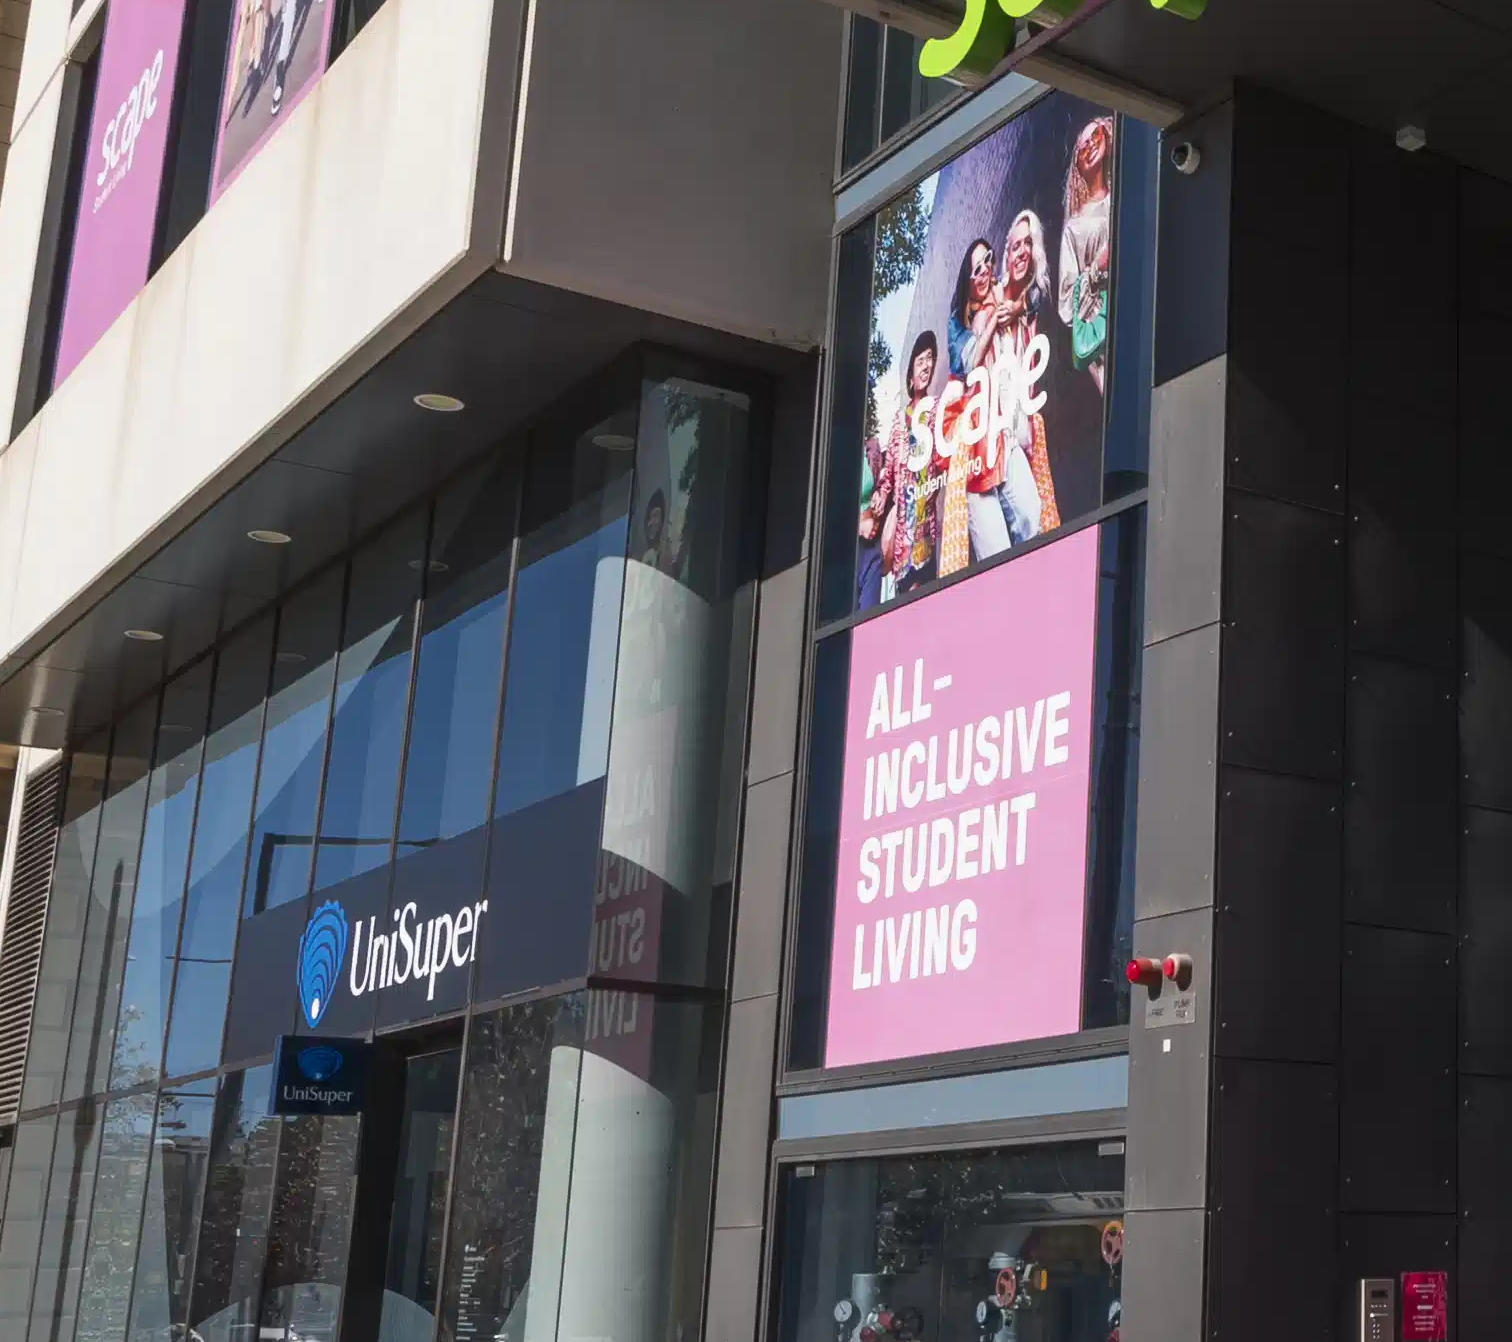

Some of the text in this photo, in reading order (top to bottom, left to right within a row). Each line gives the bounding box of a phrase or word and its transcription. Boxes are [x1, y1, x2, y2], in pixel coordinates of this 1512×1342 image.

[96, 48, 165, 187] scape
[906, 332, 1051, 473] scape
[905, 471, 949, 502] Student
[865, 657, 953, 740] ALL-
[862, 690, 1072, 821] INCLUSIVE
[856, 790, 1037, 904] STUDENT
[349, 899, 489, 1001] UniSuper
[852, 897, 978, 991] LIVING
[283, 1084, 355, 1105] UniSuper
